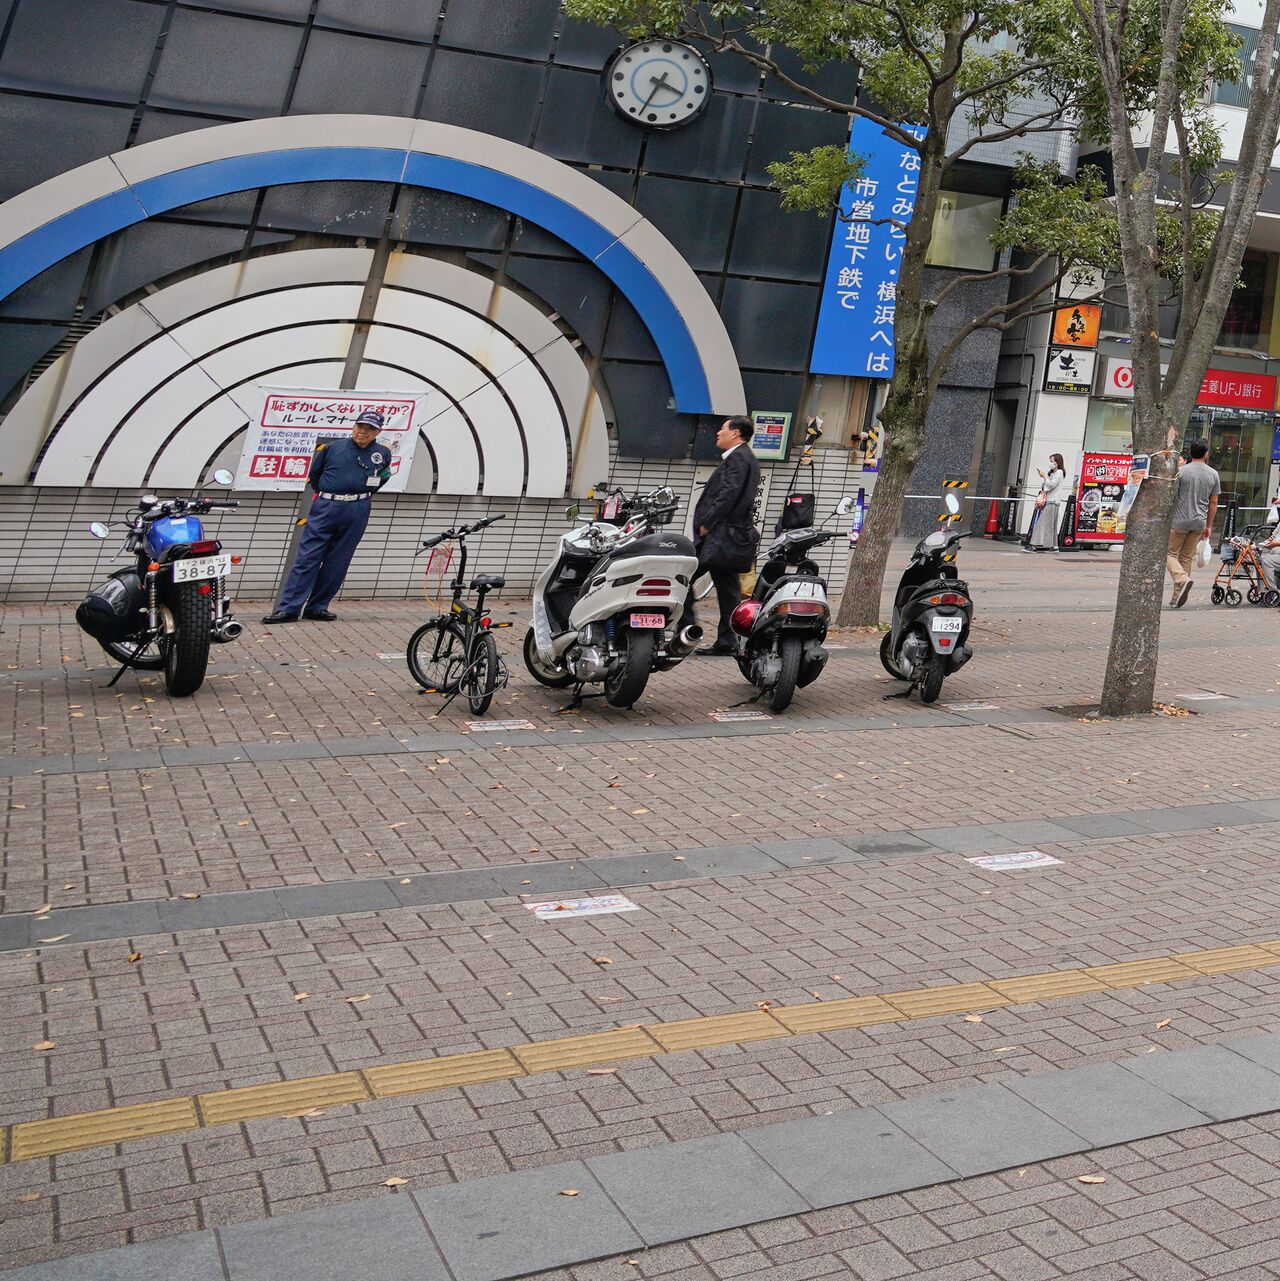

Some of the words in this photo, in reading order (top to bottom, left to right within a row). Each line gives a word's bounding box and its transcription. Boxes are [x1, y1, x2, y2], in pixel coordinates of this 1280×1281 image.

[836, 177, 879, 310] 市営地下鉄で
[178, 563, 227, 581] 38-87
[639, 617, 663, 625] 31-68
[940, 623, 960, 631] 1294
